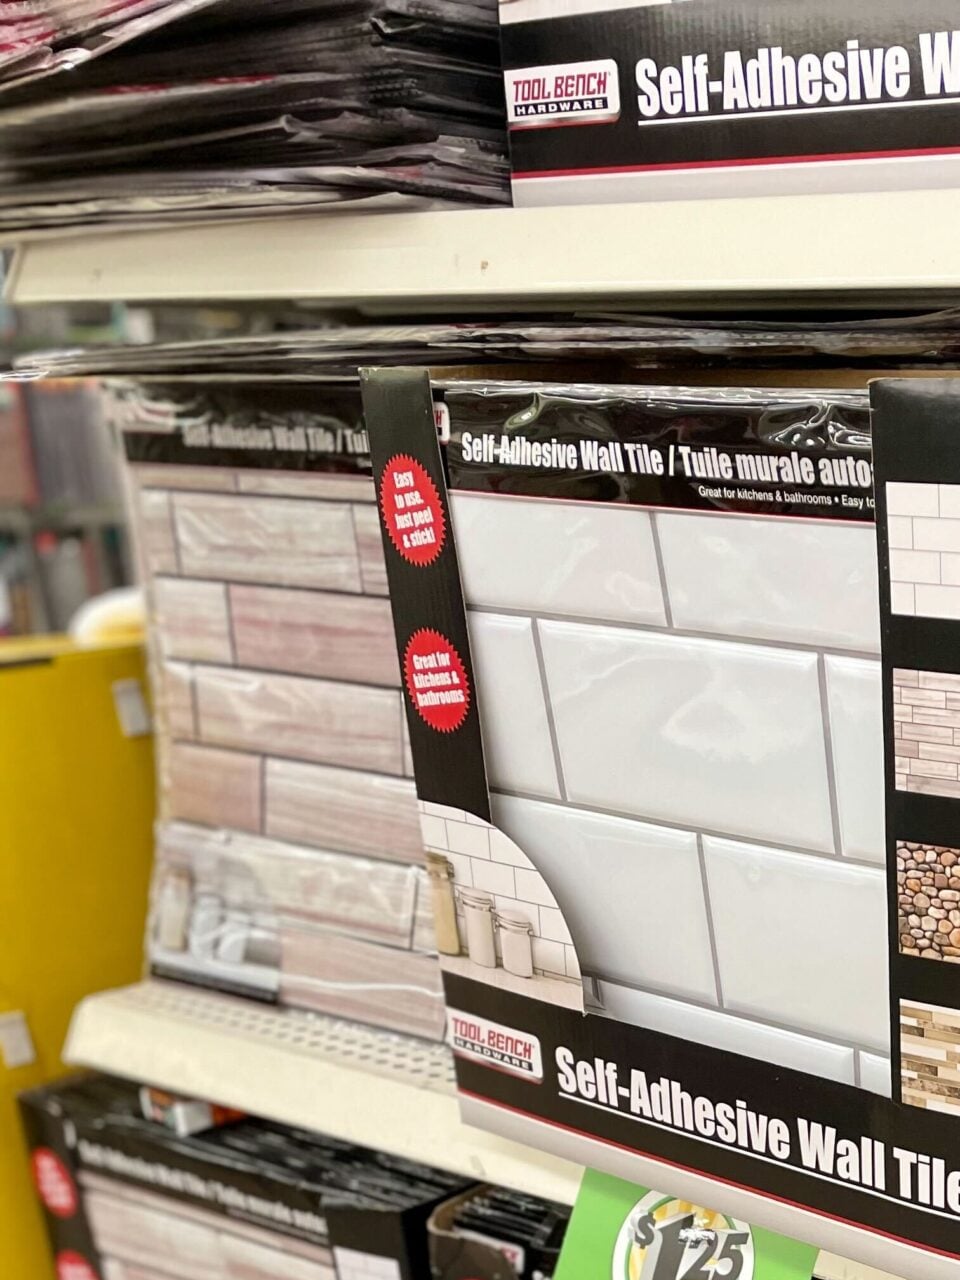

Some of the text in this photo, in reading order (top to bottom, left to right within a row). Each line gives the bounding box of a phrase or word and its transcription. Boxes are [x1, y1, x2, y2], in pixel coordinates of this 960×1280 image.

[513, 72, 608, 102] TOOL BENCH
[634, 39, 911, 117] Self-Adhesive
[516, 98, 605, 115] HARDWARE
[461, 431, 816, 485] Self-Adhesive Wall Tile / Tuile murale
[393, 471, 415, 489] Easy
[394, 493, 405, 509] to
[699, 485, 722, 498] Great
[723, 486, 736, 499] for
[737, 486, 773, 502] kitchens
[775, 490, 783, 502] &
[784, 491, 832, 505] bathrooms
[842, 495, 864, 510] Easy
[394, 506, 434, 530] Just peel
[402, 526, 436, 548] & stick!
[412, 651, 450, 670] Great for
[413, 670, 460, 689] kitchens &
[416, 689, 465, 707] bathrooms
[452, 1017, 532, 1060] TOOL BENCH
[456, 1038, 530, 1070] HARDWARE
[555, 1045, 790, 1160] Self-Adhesive
[797, 1117, 885, 1191] Wall
